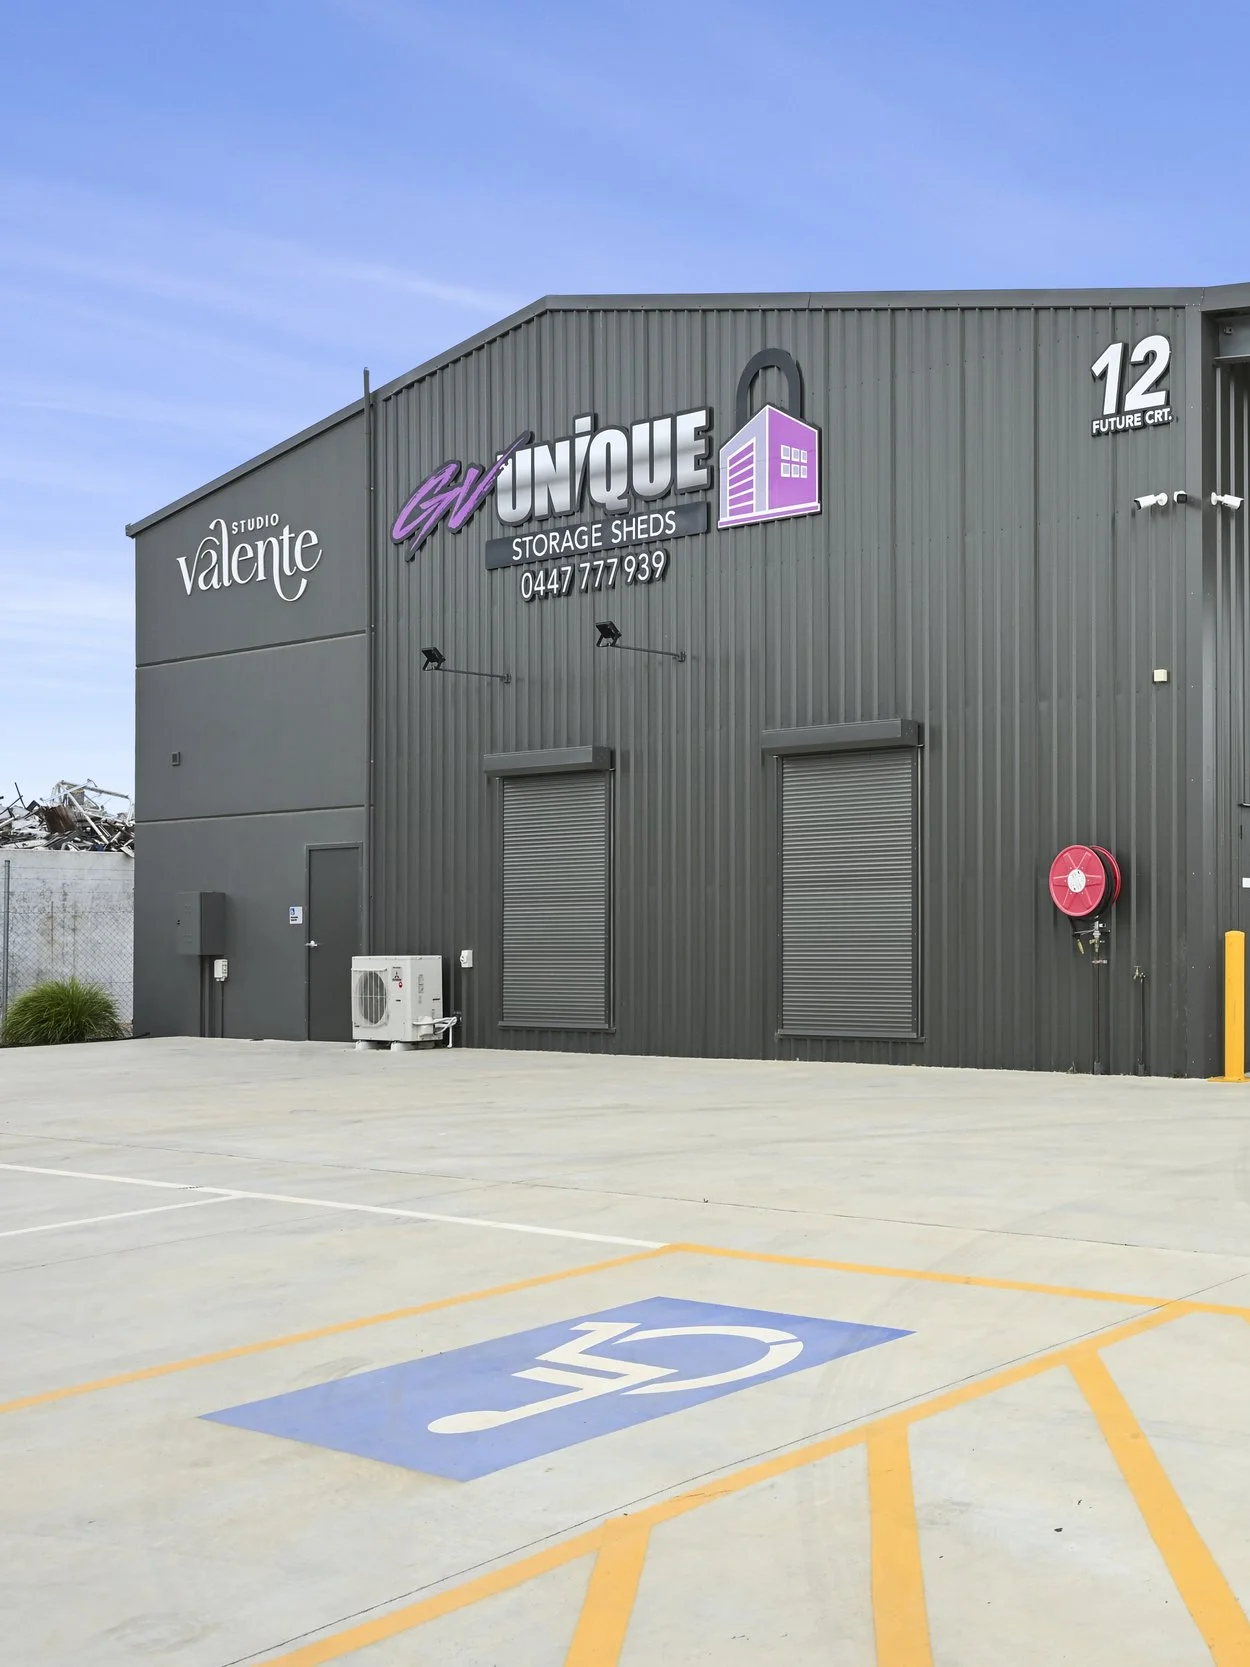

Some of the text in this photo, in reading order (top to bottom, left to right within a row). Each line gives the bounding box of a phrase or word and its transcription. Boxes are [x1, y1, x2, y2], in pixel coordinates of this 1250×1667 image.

[1090, 334, 1171, 416] 12
[1091, 407, 1173, 435] FUTURE CRT.
[391, 438, 525, 552] GV
[231, 513, 280, 535] STUDIO
[512, 510, 676, 562] STORAGE SHEDS
[520, 550, 666, 600] 0447 777 939
